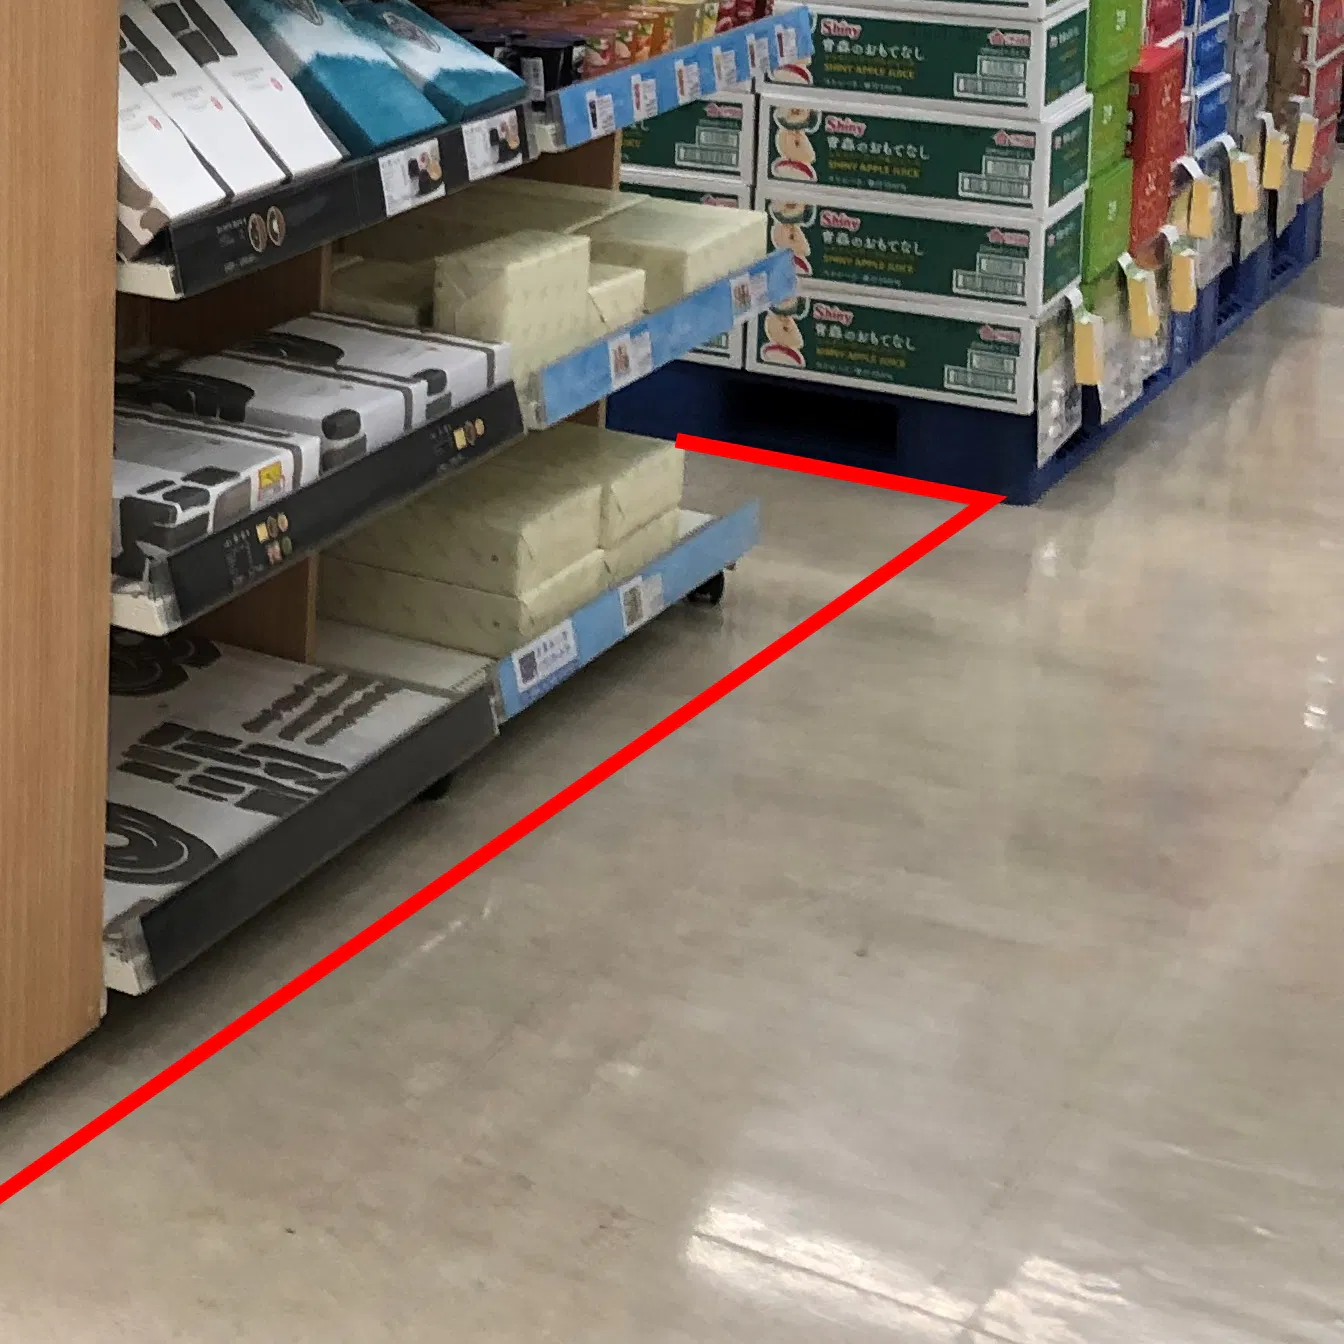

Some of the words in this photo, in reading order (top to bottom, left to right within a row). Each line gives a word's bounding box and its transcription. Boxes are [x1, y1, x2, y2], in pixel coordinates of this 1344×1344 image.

[822, 20, 861, 39] Shiny
[823, 38, 925, 61] 青森のおもてなし
[827, 117, 865, 135] Shiny
[828, 136, 930, 160] 青森のおもてなし
[821, 211, 860, 230] Shiny
[822, 230, 924, 255] 青森のおもてなし
[814, 305, 853, 325] Shiny
